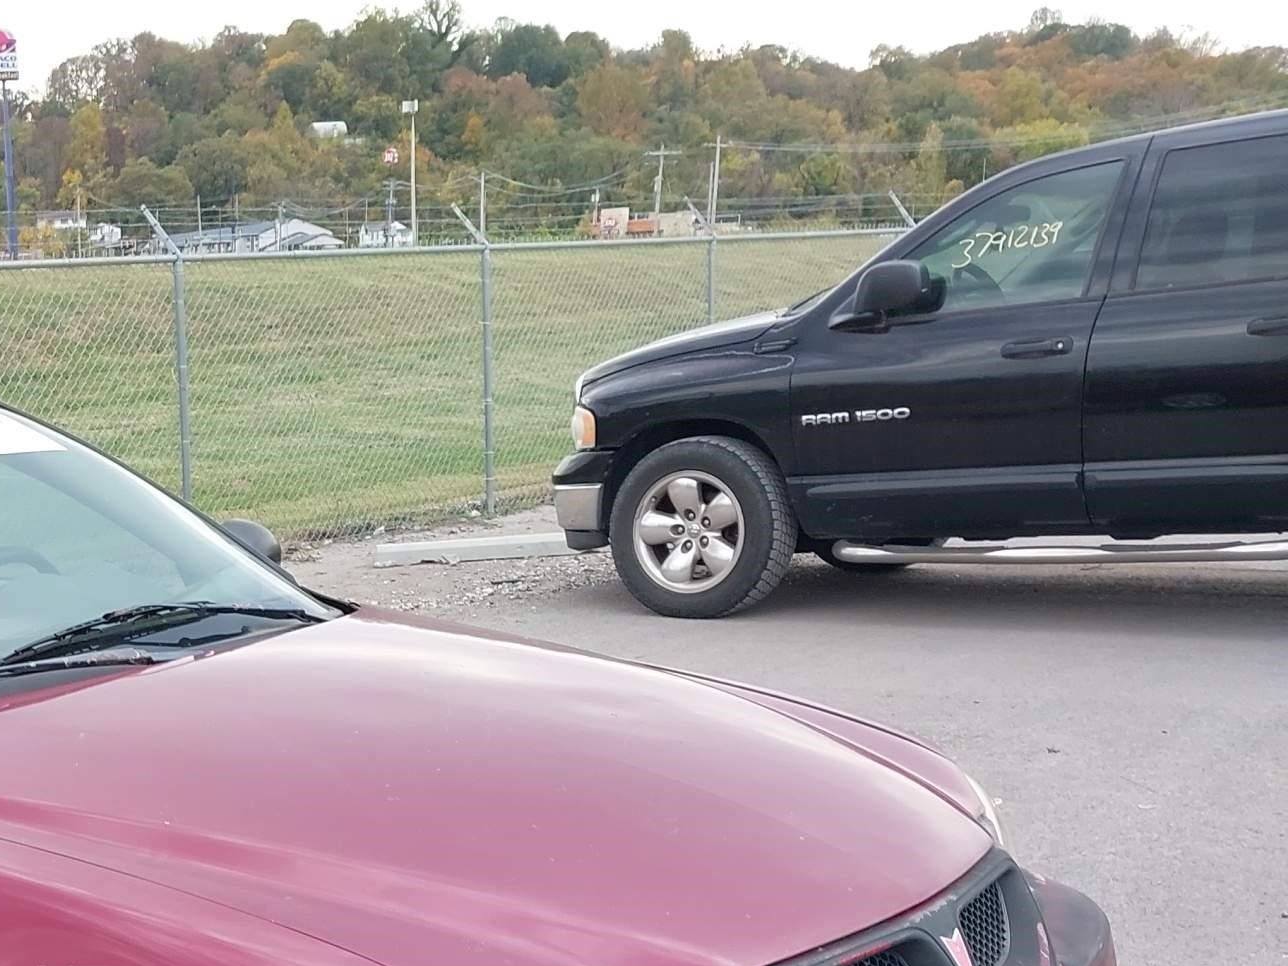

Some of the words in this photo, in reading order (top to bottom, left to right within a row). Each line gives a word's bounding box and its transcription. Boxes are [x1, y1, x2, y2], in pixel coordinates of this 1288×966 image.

[951, 221, 1063, 269] 37912139
[801, 412, 850, 426] RAM
[854, 407, 911, 422] 1500
